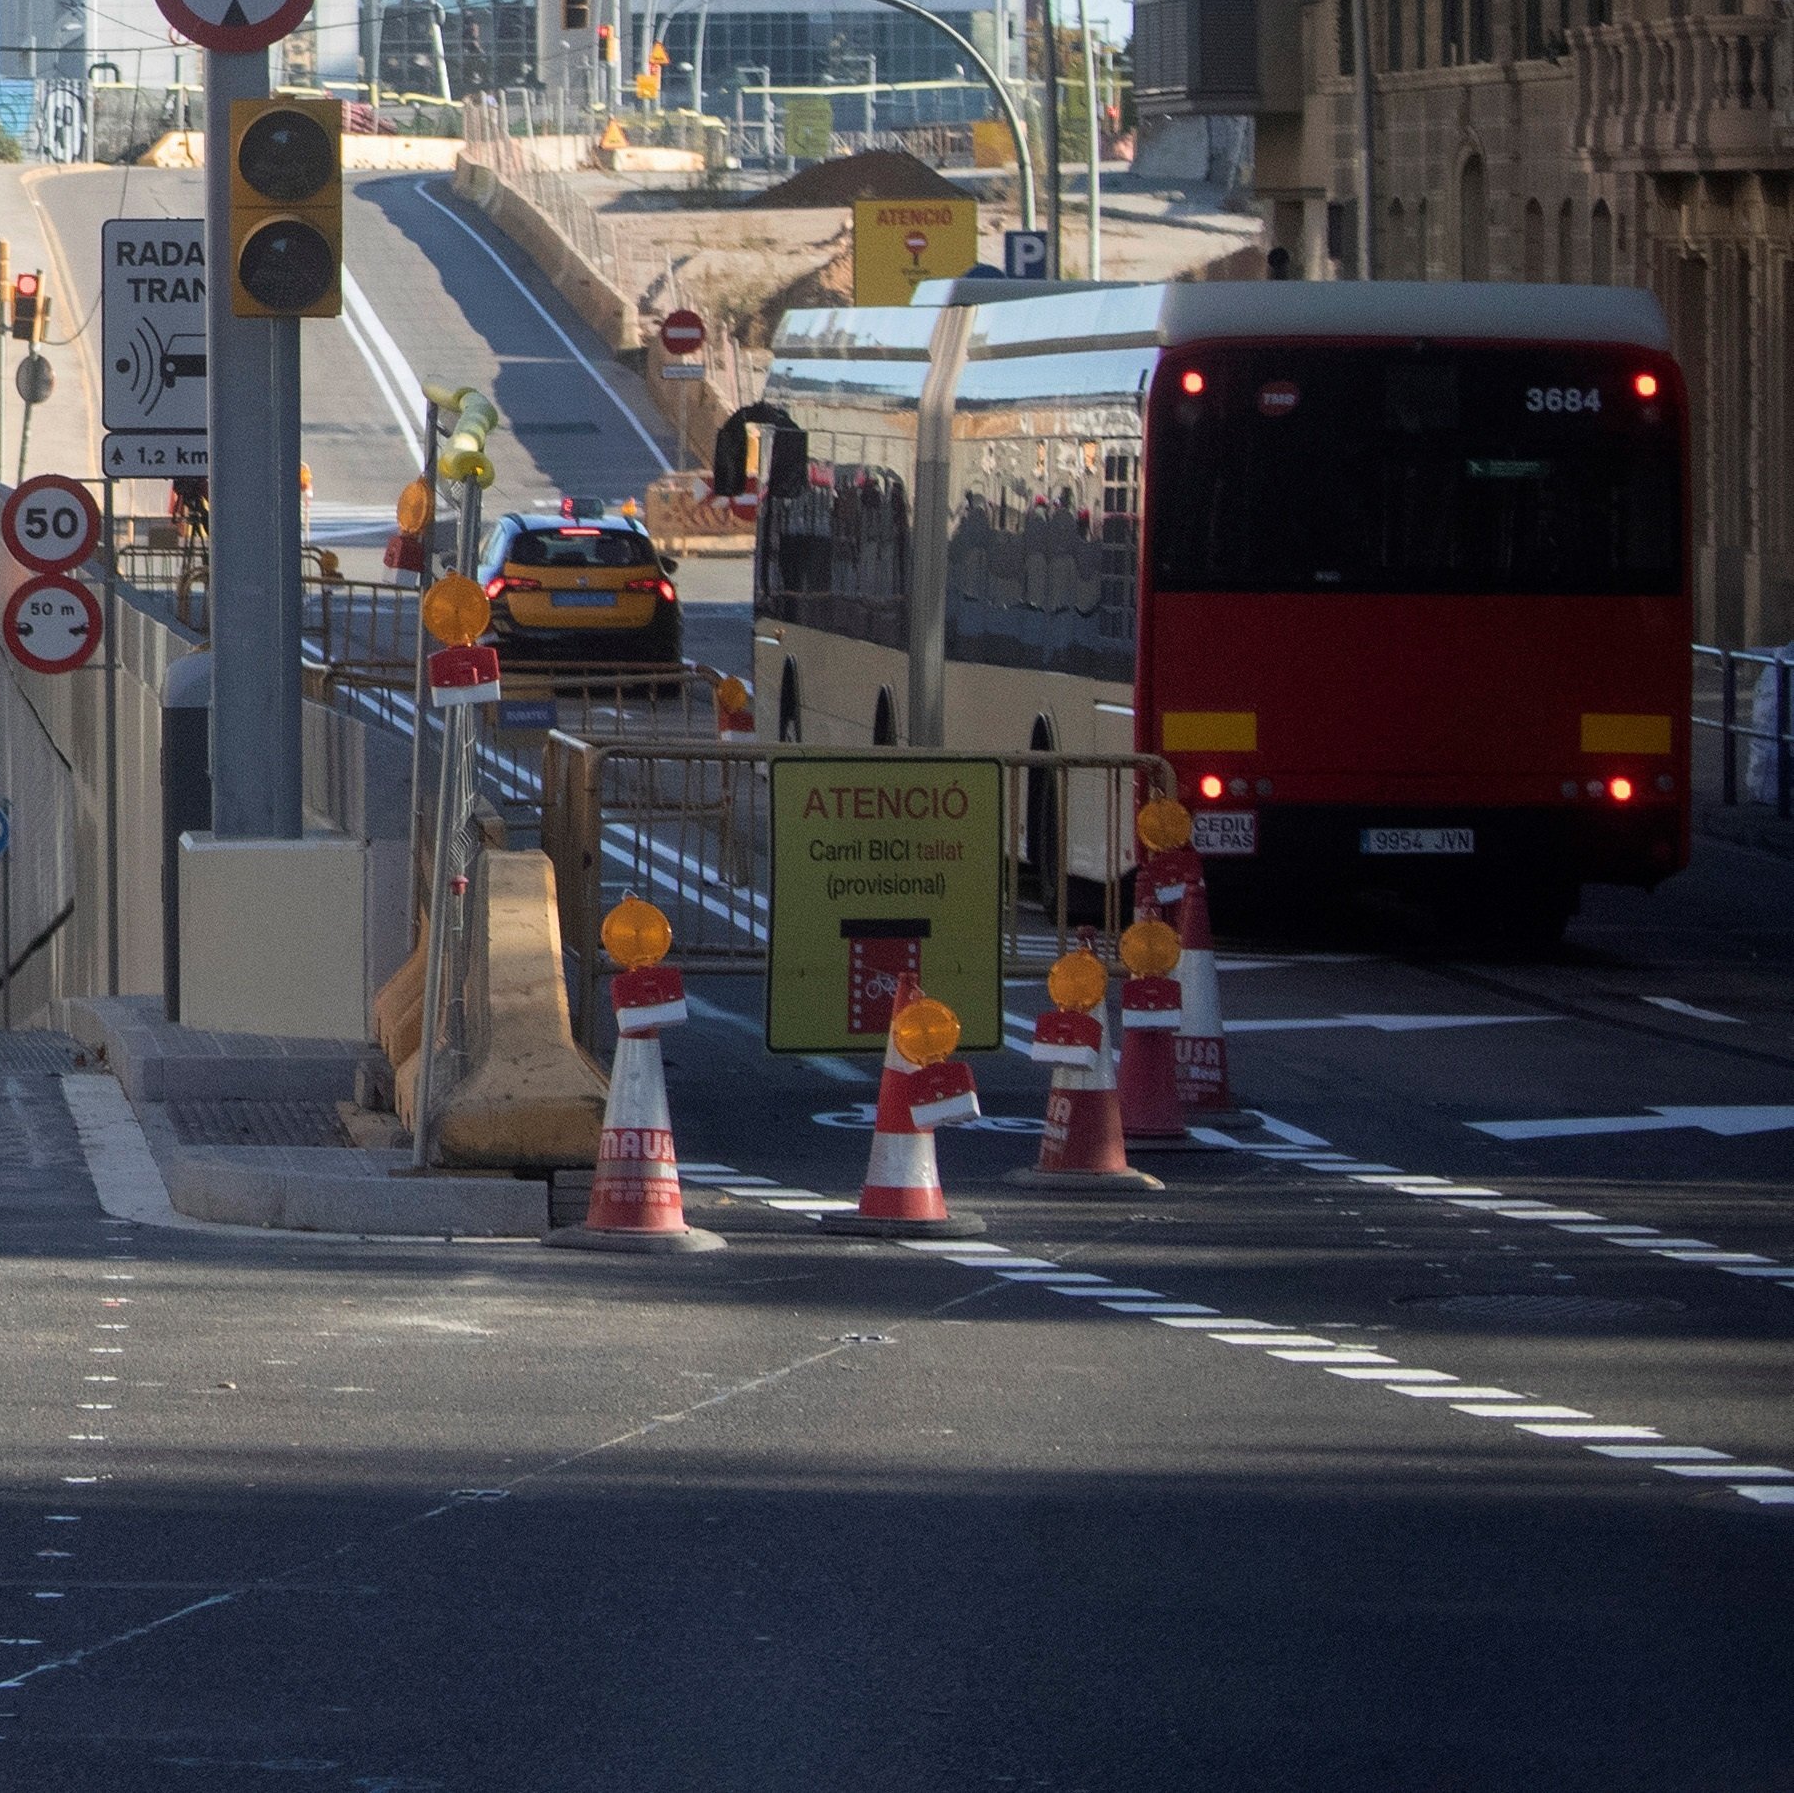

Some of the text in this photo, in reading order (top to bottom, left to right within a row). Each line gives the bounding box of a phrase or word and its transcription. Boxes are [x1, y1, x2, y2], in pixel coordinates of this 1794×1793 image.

[116, 241, 206, 266] RADA
[1015, 235, 1046, 277] P
[1525, 387, 1603, 413] 3684
[137, 447, 209, 466] 1,2 km
[24, 507, 79, 539] 50
[30, 602, 75, 616] 50 m
[802, 781, 970, 820] ATENCIÓ
[1194, 817, 1254, 832] CEDIU
[809, 839, 965, 861] Carril BICI tallat
[1194, 833, 1254, 848] EL PAS
[1375, 831, 1471, 851] 9954 JVN
[826, 871, 946, 901] (provisional)
